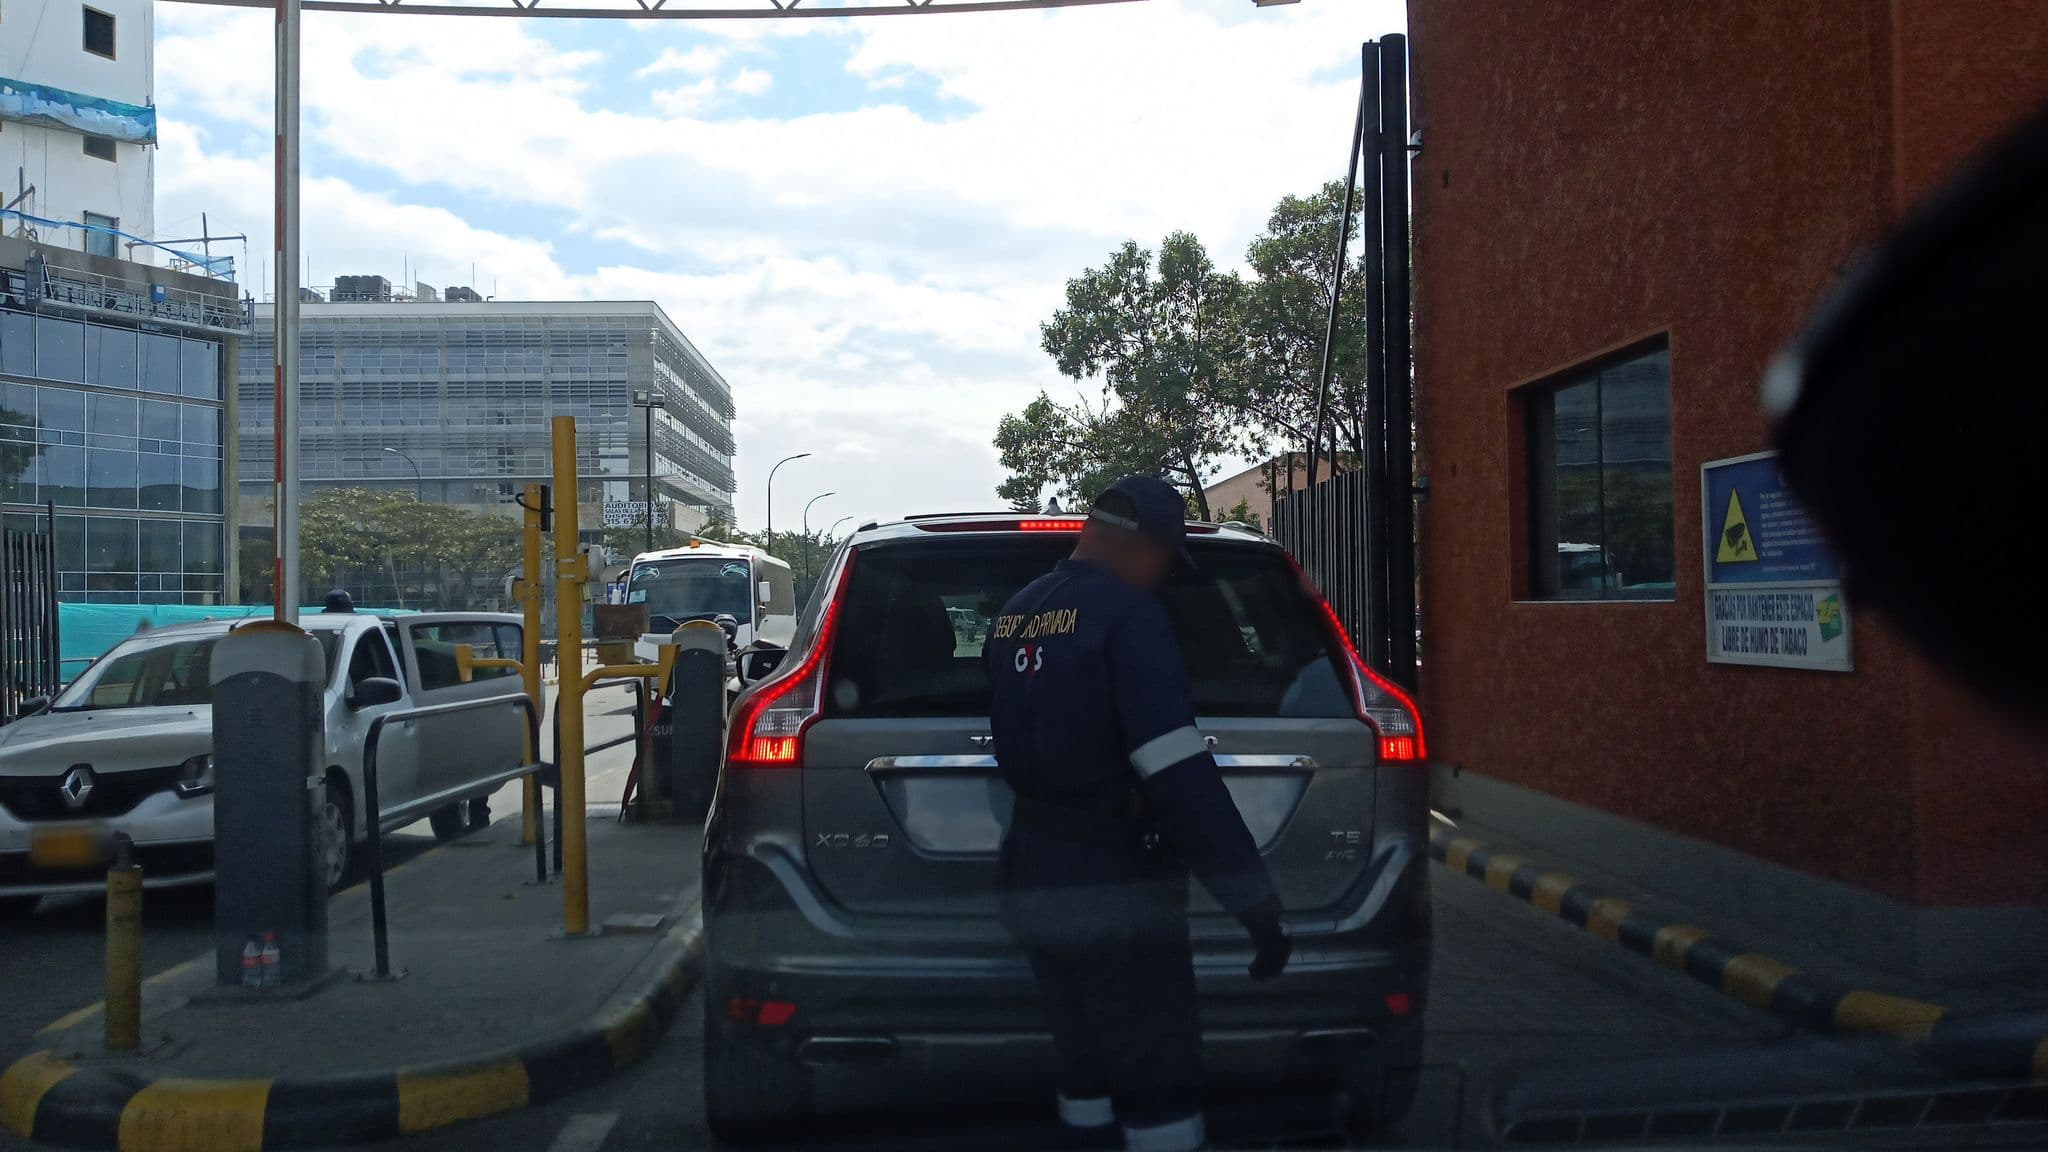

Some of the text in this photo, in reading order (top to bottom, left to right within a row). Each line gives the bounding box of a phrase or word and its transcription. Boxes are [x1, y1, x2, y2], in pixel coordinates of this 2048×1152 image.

[993, 607, 1078, 639] SEGURAD PRIVADA
[1714, 593, 1814, 622] GRACIAS POR MANTENER ESTE ESPACIO
[1722, 625, 1808, 656] LIBRE DE HUMO DE TABACO
